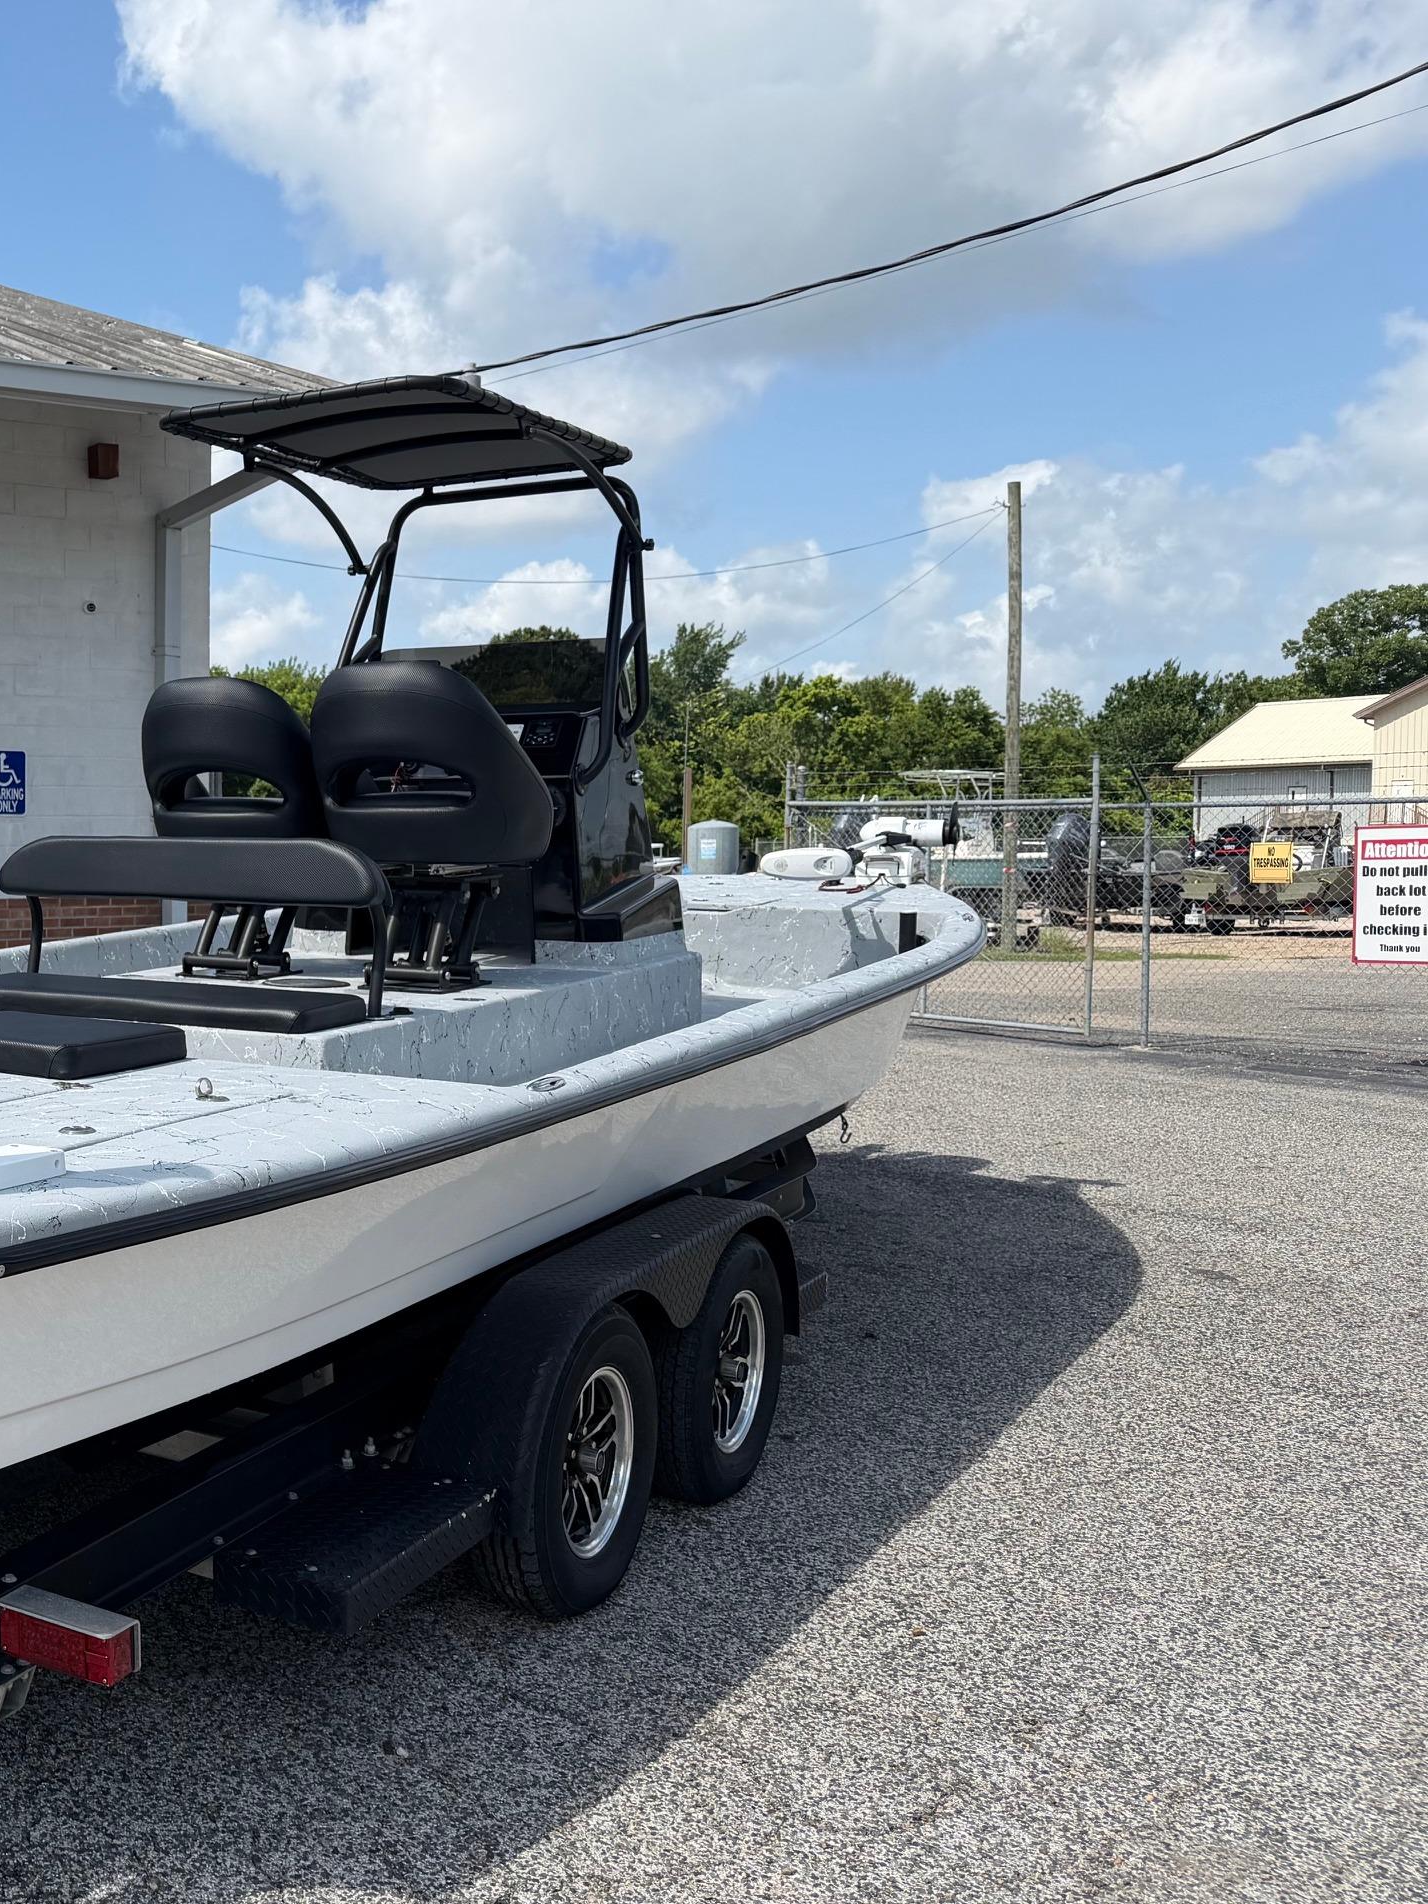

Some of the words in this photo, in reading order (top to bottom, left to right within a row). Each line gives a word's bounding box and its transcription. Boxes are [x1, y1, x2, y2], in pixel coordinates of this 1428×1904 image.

[1267, 846, 1276, 856] NO
[1364, 841, 1428, 858] Attentio
[1253, 857, 1289, 868] TRESPASSING
[1362, 865, 1377, 877] Do
[1379, 866, 1400, 877] not
[1402, 865, 1428, 877] pull
[1376, 885, 1406, 897] back
[1409, 885, 1427, 897] lot
[1379, 904, 1422, 916] before
[1362, 924, 1420, 937] checking
[1379, 943, 1404, 953] Thank
[1405, 945, 1421, 953] you
